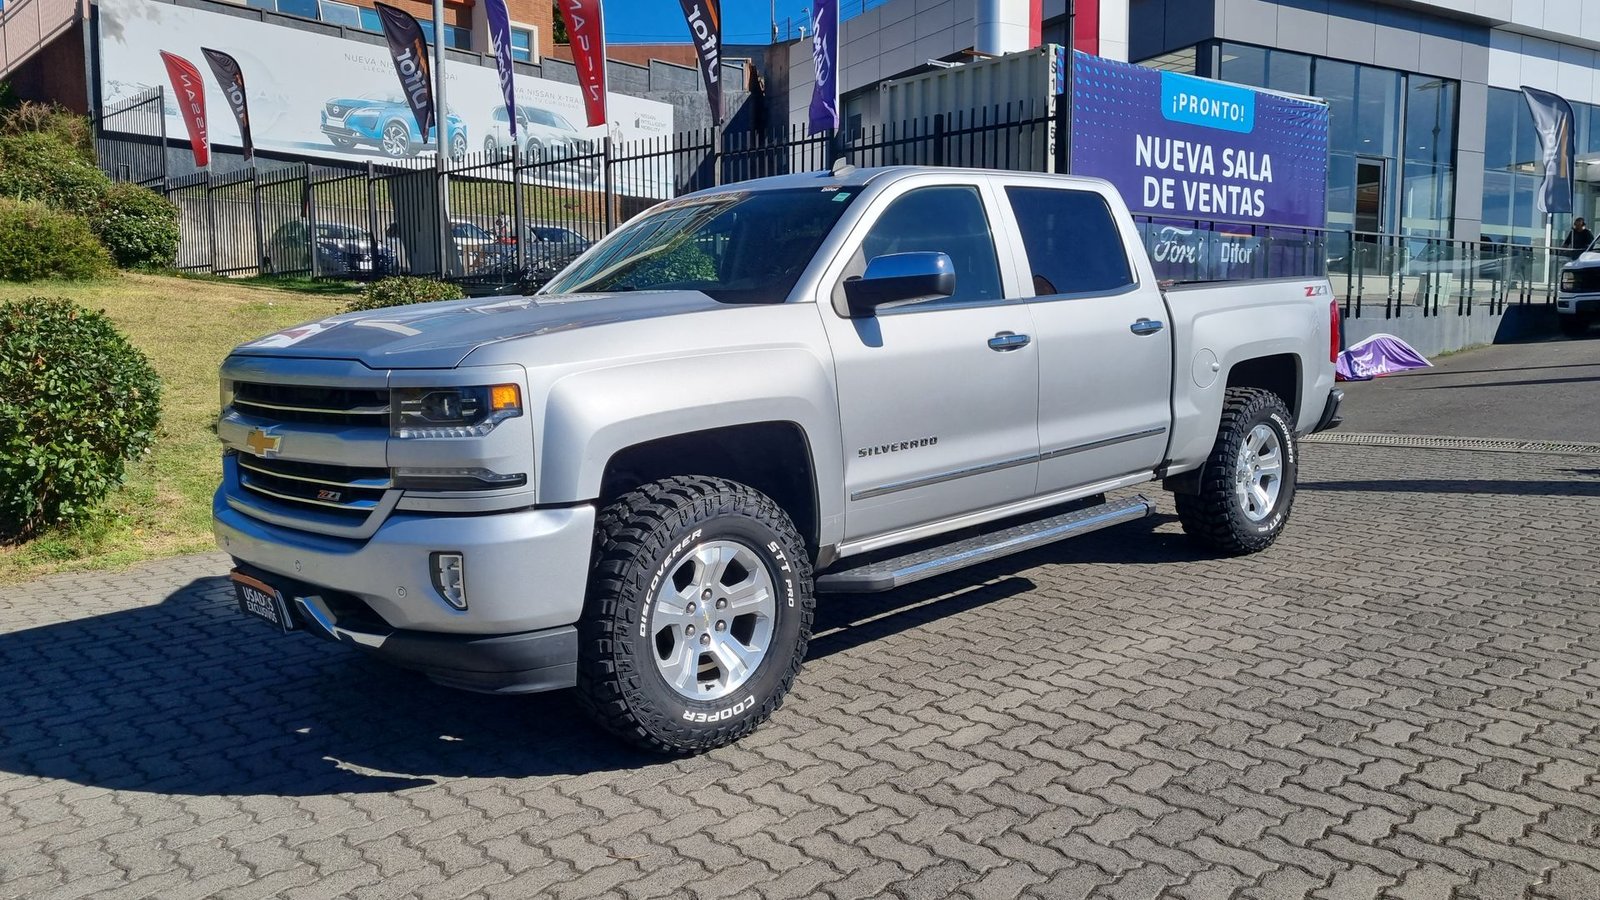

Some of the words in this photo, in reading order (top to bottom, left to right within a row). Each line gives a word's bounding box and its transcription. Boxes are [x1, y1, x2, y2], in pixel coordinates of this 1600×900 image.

[344, 53, 377, 66] NUEVA
[1173, 93, 1245, 122] ¡PRONTO!
[1135, 134, 1215, 176] NUEVA
[1222, 148, 1273, 183] SALA
[1143, 176, 1175, 209] DE
[1182, 180, 1265, 217] VENTAS
[1221, 242, 1252, 264] Difor
[858, 436, 938, 458] SILVERADO
[1270, 413, 1294, 463] DISCOVERER
[639, 528, 703, 637] DISCOVERER
[766, 540, 792, 574] STT
[785, 579, 795, 608] PRO
[682, 695, 756, 723] COOPER
